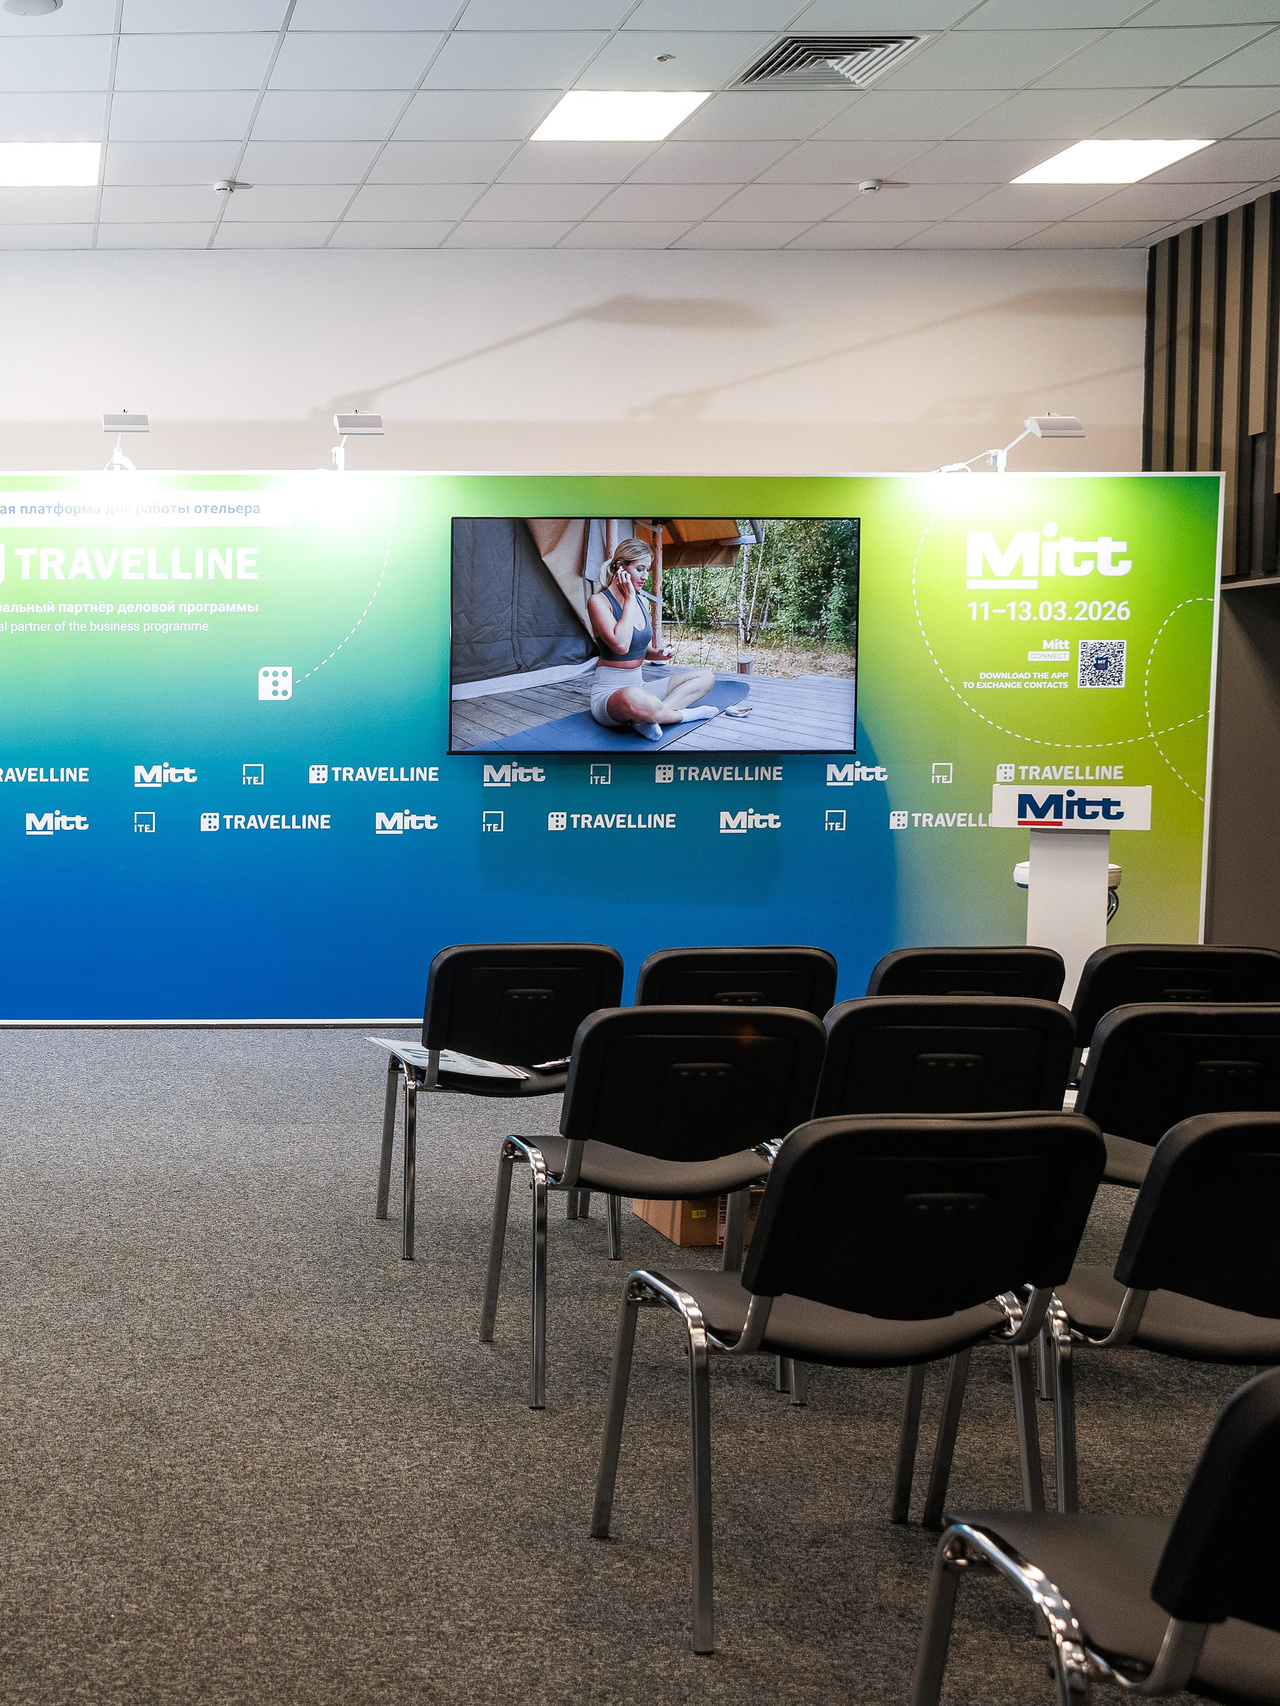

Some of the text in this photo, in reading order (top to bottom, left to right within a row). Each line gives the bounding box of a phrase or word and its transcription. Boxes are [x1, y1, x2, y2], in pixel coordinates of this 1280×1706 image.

[20, 502, 101, 517] платформа
[136, 502, 190, 517] работы
[194, 504, 260, 517] отельера
[966, 522, 1132, 577] Mitt
[14, 548, 260, 580] TRAVELLINE
[58, 601, 114, 615] партнёр
[117, 601, 175, 615] деловой
[179, 602, 259, 615] программы
[11, 622, 51, 634] partner
[54, 620, 67, 632] of
[69, 621, 87, 632] the
[90, 621, 140, 632] business
[143, 622, 209, 634] programme
[1042, 639, 1069, 650] Mitt
[980, 672, 1069, 680] DOWNLOAD THE APP
[134, 762, 197, 783] Mitt
[331, 767, 438, 781] TRAVELLINE
[484, 762, 545, 783] Mitt
[678, 767, 782, 781] TRAVELLINE
[827, 761, 888, 782] Mitt
[1019, 766, 1123, 780] TRAVELLINE
[1017, 789, 1125, 820] Mitt
[26, 810, 88, 831] Mitt
[223, 815, 330, 829] TRAVELLINE
[376, 809, 437, 830] Mitt
[571, 814, 676, 828] TRAVELLINE
[720, 808, 781, 829] Mitt
[912, 813, 992, 827] TRAVELLI
